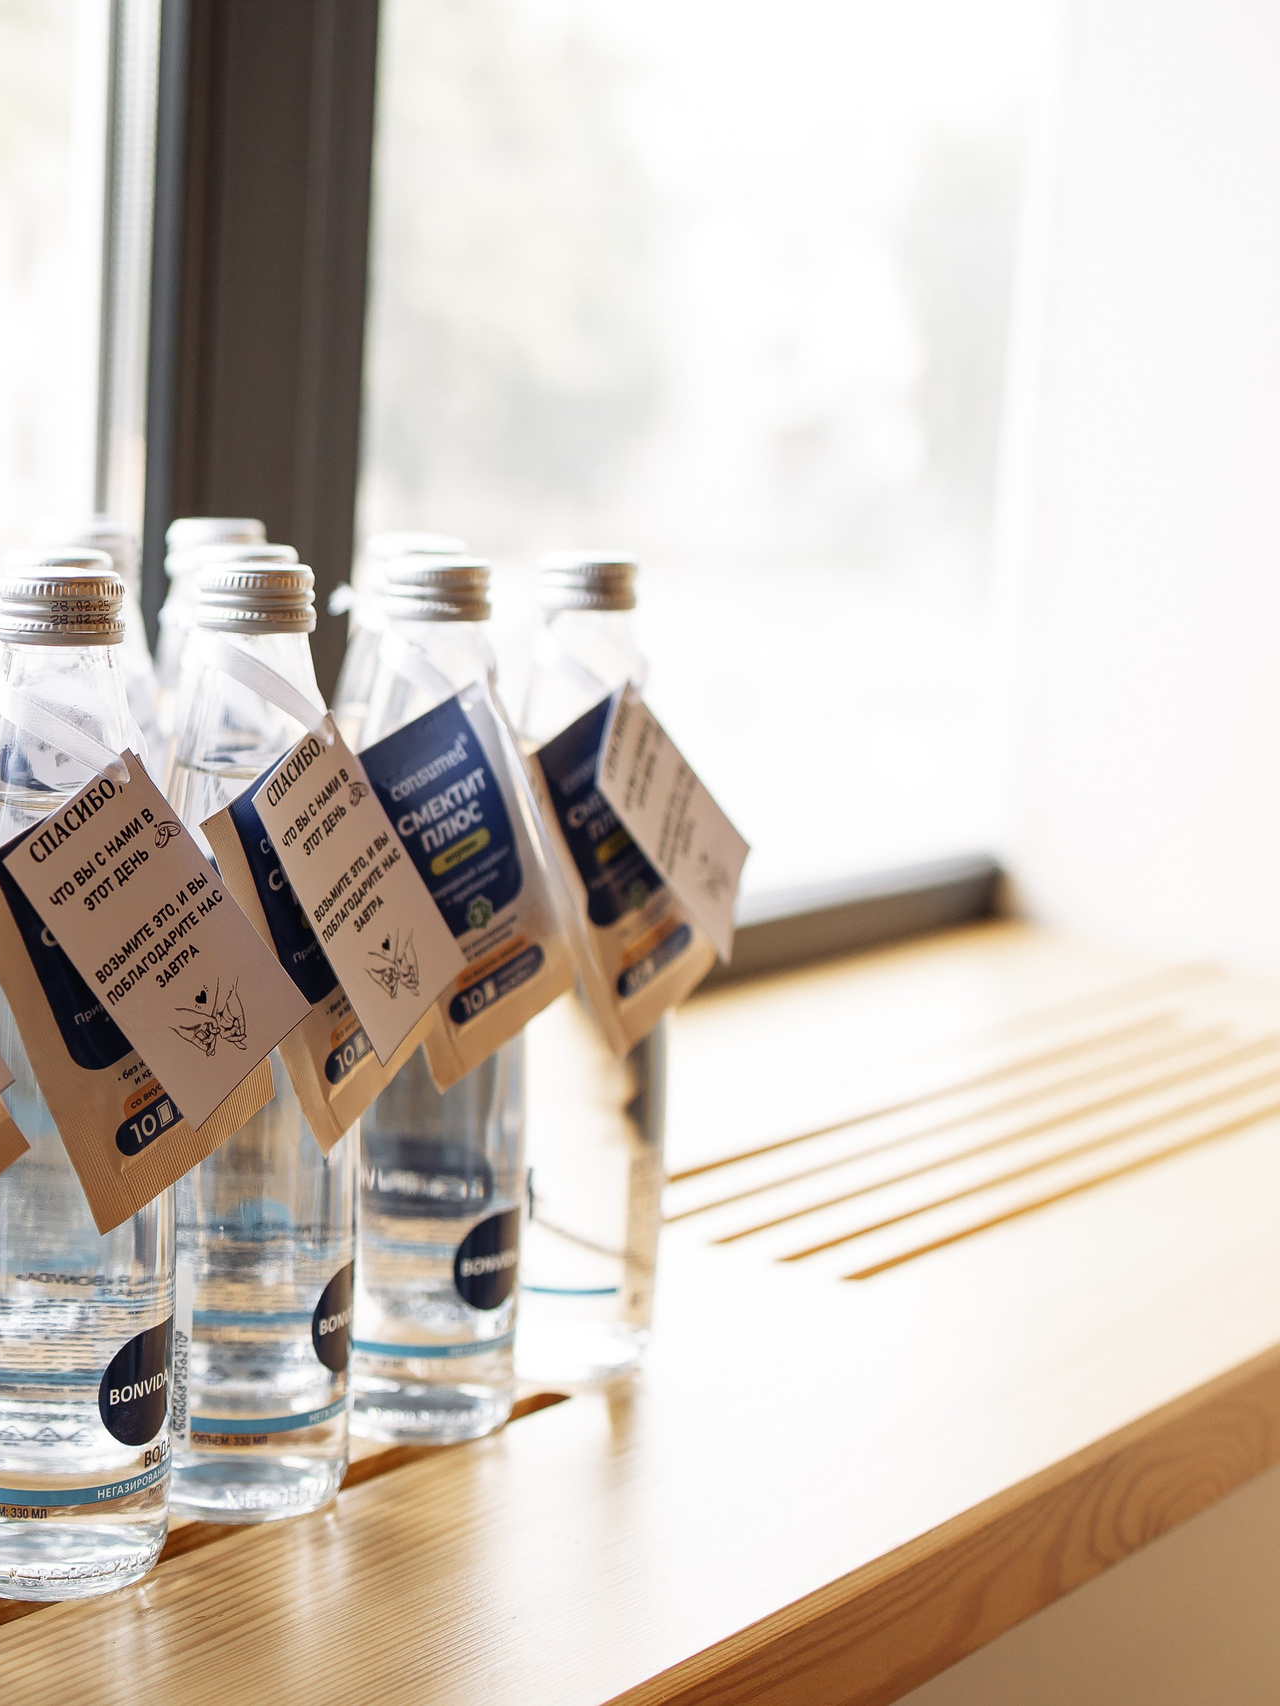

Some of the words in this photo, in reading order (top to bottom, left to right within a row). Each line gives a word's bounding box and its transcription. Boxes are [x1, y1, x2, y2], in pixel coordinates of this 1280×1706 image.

[50, 600, 110, 612] 28.02.25
[50, 614, 110, 626] 28.02.26
[267, 738, 326, 807] СПАСИБО,
[390, 739, 468, 802] consumed
[29, 779, 123, 863] СПАСИБО,
[282, 826, 297, 848] ЧТО
[295, 810, 310, 833] ВЫ
[308, 803, 317, 816] С
[315, 776, 342, 810] НАМИ
[339, 768, 349, 782] В
[397, 767, 486, 838] СМЕКТИТ
[421, 800, 483, 854] ПЛЮС
[49, 881, 75, 906] ЧТО
[73, 861, 96, 887] ВЫ
[95, 852, 106, 866] С
[104, 817, 143, 857] НАМИ
[141, 808, 154, 824] В
[303, 827, 323, 856] ЭТОТ
[322, 805, 347, 837] ДЕНЬ
[84, 877, 114, 911] ЭТОТ
[113, 850, 149, 887] ДЕНЬ
[314, 872, 352, 923] ВОЗЬМИТЕ
[350, 856, 369, 878] ЭТО,
[366, 845, 376, 860] И
[374, 831, 390, 851] ВЫ
[322, 866, 384, 944] ПОБЛАГОДАРИТЕ
[382, 848, 401, 872] НАС
[95, 923, 155, 984] ВОЗЬМИТЕ
[153, 903, 180, 928] ЭТО,
[176, 890, 189, 906] И
[186, 872, 208, 896] ВЫ
[354, 895, 384, 932] ЗАВТРА
[106, 911, 200, 1006] ПОБЛАГОДАРИТЕ
[197, 890, 223, 917] НАС
[156, 944, 200, 988] ЗАВТРА
[335, 1044, 355, 1074] 10
[129, 1113, 157, 1144] 10
[130, 1098, 142, 1109] со
[109, 1368, 169, 1406] BONVIDA
[193, 1434, 231, 1445] ОБЪЕМ:
[234, 1436, 250, 1446] 330
[252, 1436, 268, 1445] МЛ
[11, 1509, 29, 1518] 330
[32, 1509, 47, 1519] МЛ
